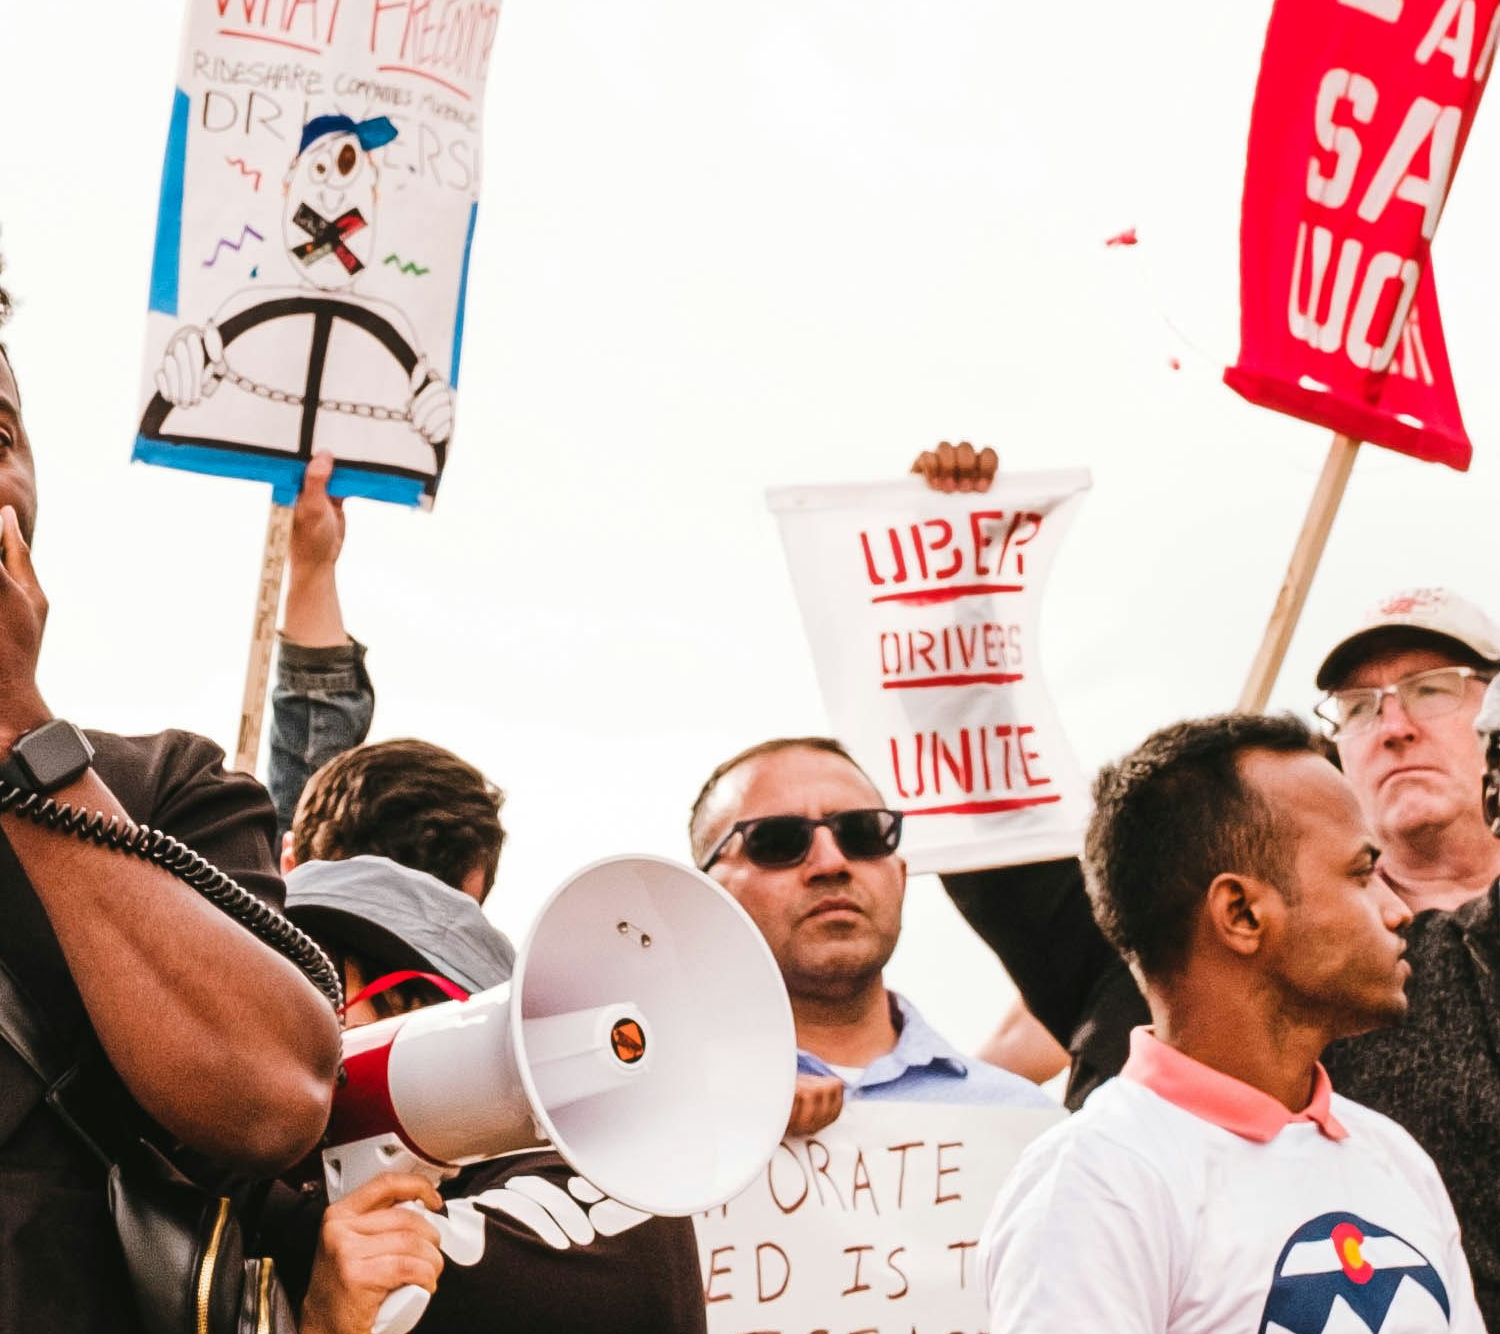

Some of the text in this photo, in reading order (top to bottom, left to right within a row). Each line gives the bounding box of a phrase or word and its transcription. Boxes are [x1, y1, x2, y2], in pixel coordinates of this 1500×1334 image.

[191, 51, 325, 96] RIDESHARE
[859, 510, 1043, 586] UBER
[880, 623, 1023, 676] DRIVERS
[890, 724, 1051, 799] UNITE
[841, 1245, 910, 1301] IS
